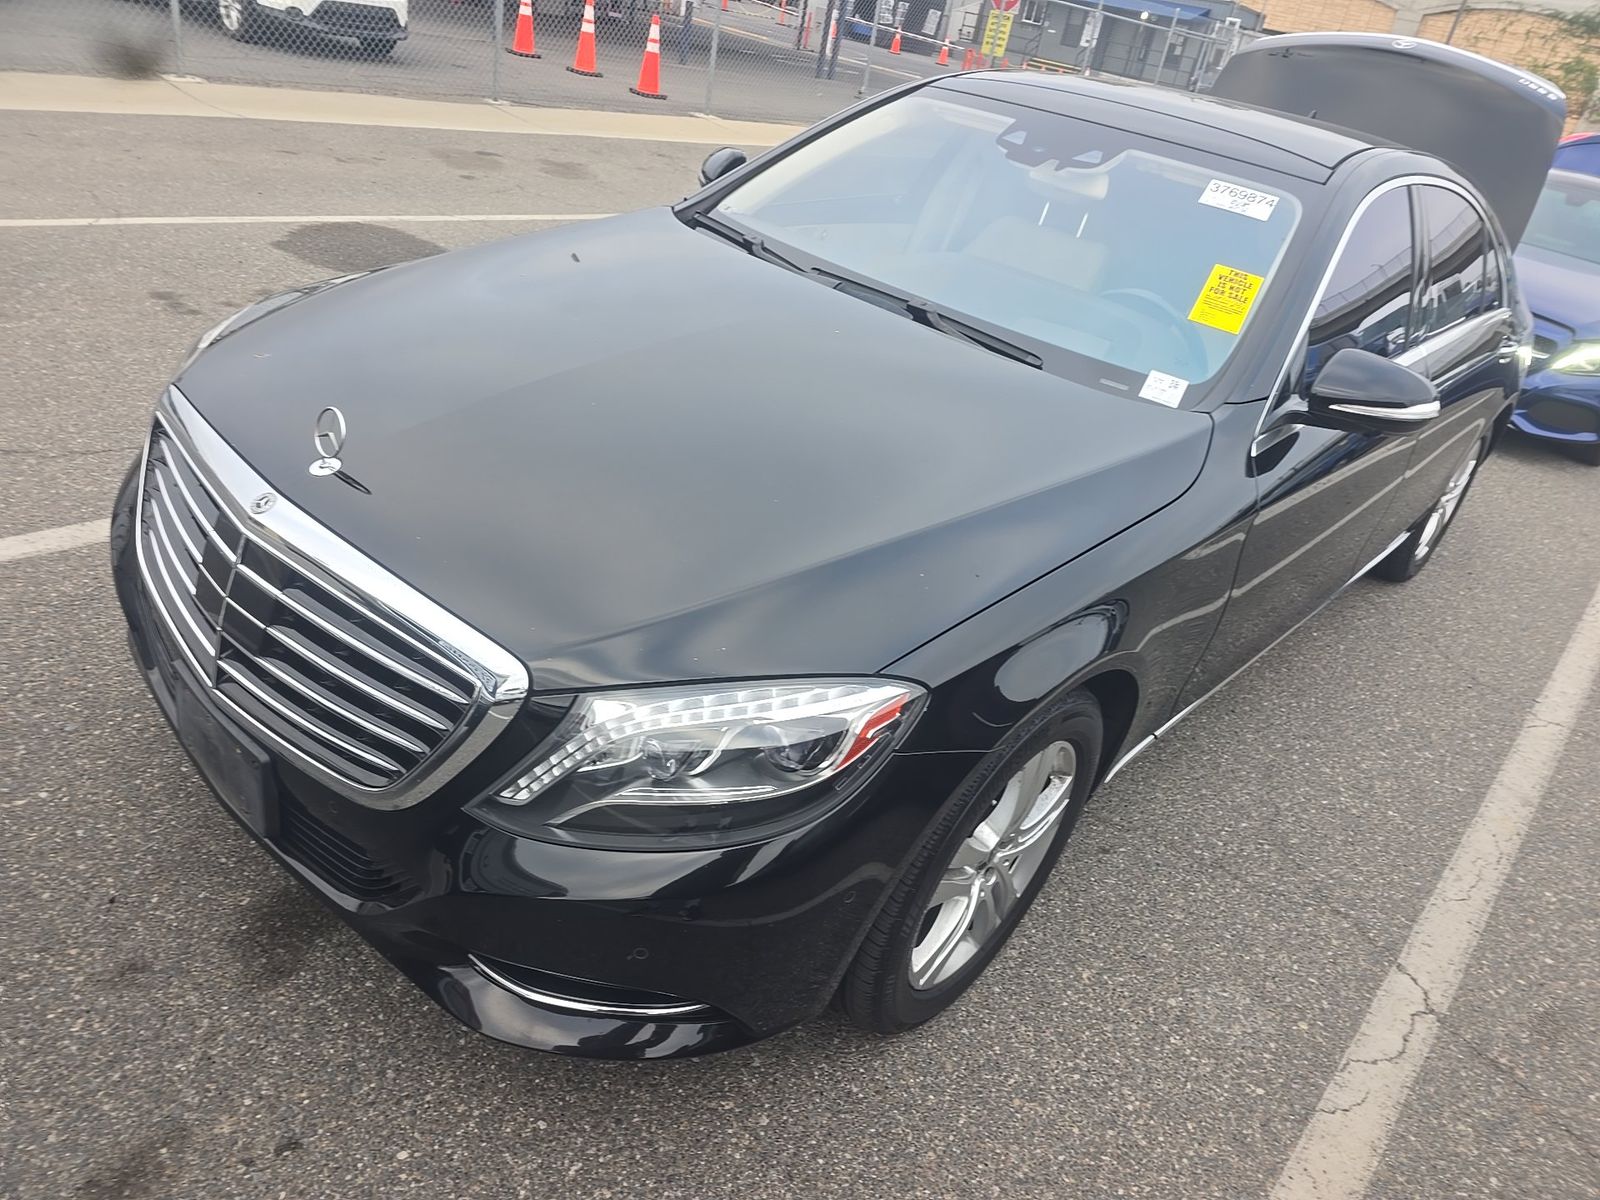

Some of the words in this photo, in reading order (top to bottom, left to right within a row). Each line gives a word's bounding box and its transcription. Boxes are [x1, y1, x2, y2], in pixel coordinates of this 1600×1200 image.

[1210, 182, 1276, 208] 3769874
[1218, 274, 1254, 290] VEHICLE
[1228, 269, 1249, 281] THIS
[1208, 286, 1226, 296] FOR
[1228, 292, 1249, 304] SALE
[1217, 281, 1227, 289] IS
[1229, 285, 1248, 295] NOT
